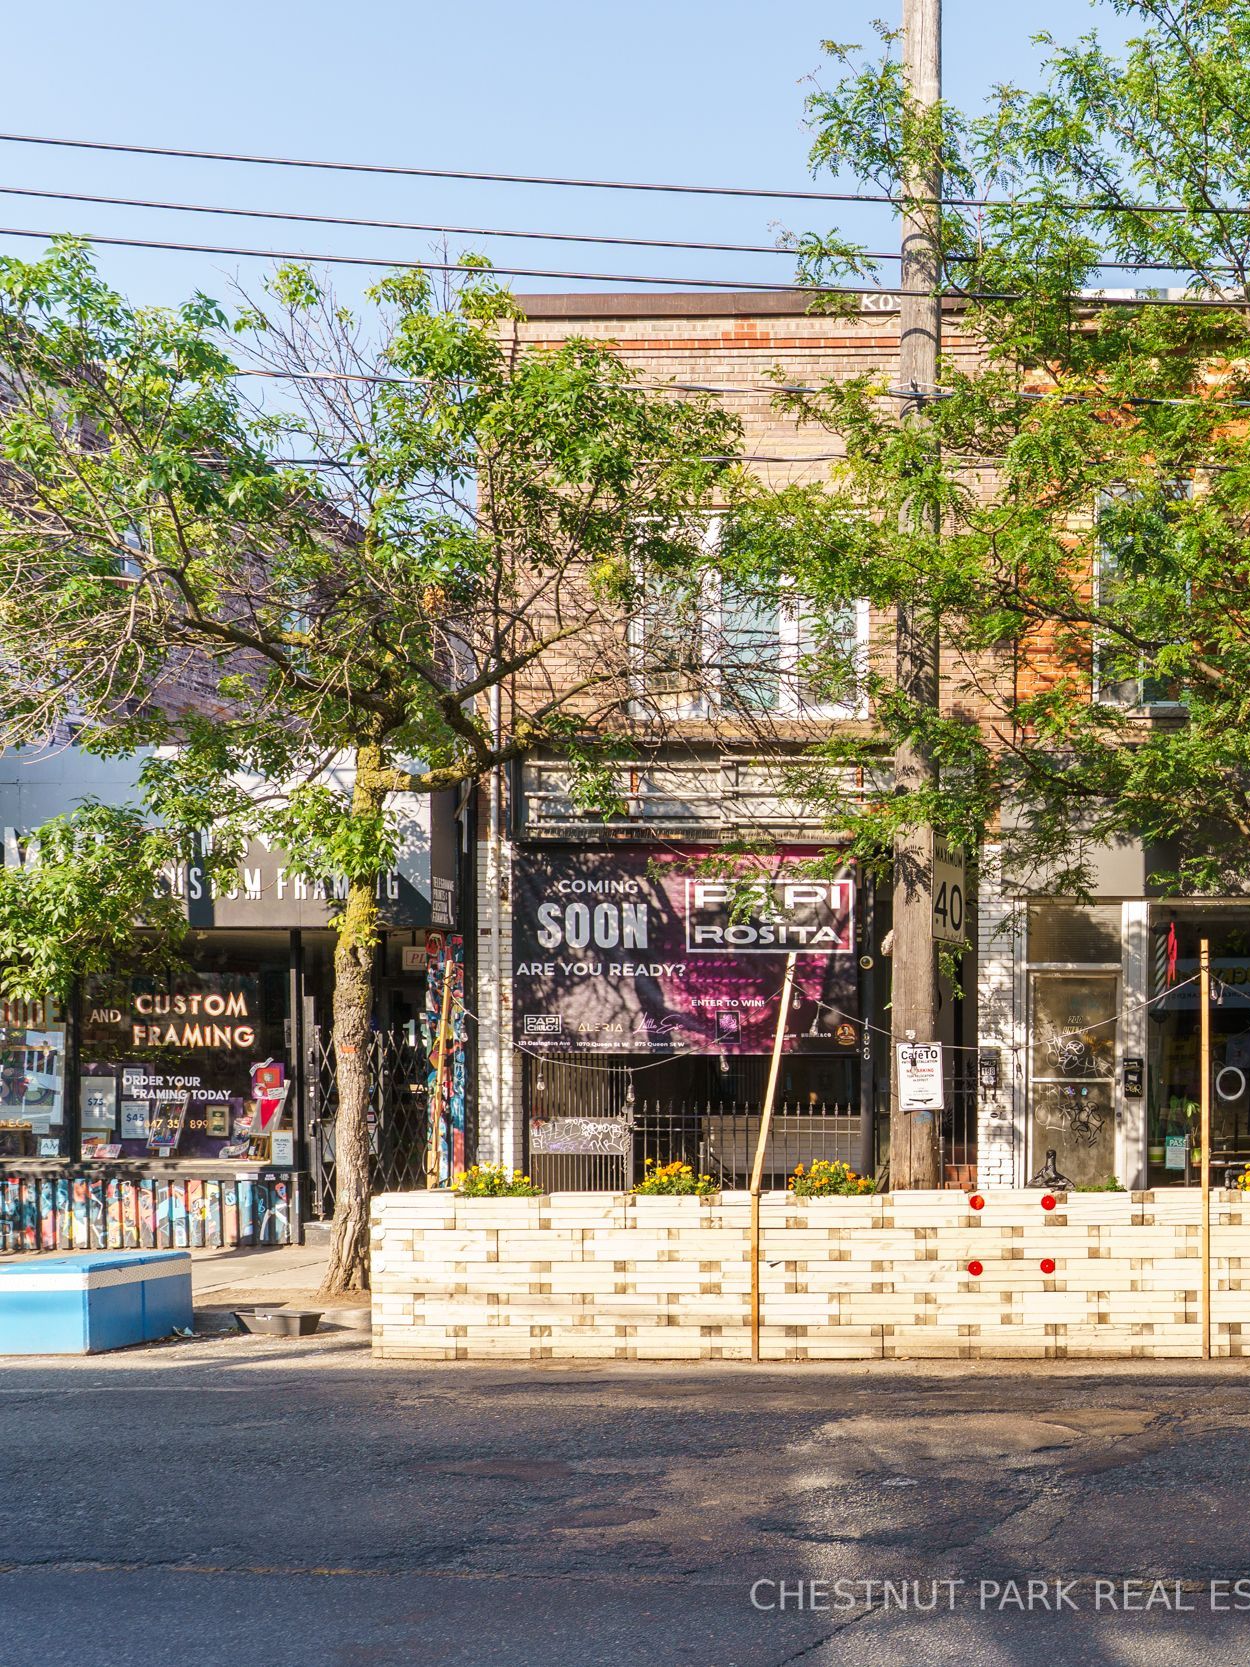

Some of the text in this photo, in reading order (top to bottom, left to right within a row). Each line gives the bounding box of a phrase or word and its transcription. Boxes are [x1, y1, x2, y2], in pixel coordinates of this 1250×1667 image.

[277, 867, 399, 900] FRAMG
[558, 879, 639, 894] COMING
[934, 881, 963, 931] 40
[537, 902, 649, 949] SOON
[694, 925, 843, 945] ROSITA
[516, 963, 687, 978] ARE YOU READY?
[135, 992, 248, 1018] CUSTOM
[691, 999, 765, 1008] ENTER TO WIN!
[89, 1009, 122, 1023] AND
[526, 1017, 559, 1025] PAPI
[526, 1024, 559, 1032] CHULO'S
[578, 1022, 623, 1032] ALERIA
[133, 1023, 255, 1049] FRAMING
[901, 1049, 938, 1060] CaféTO
[981, 1067, 996, 1075] 198
[122, 1076, 163, 1086] ORDER
[166, 1076, 201, 1087] YOUR
[132, 1089, 231, 1100] FRAMING TODAY
[87, 1098, 104, 1106] $75
[126, 1113, 145, 1123] $45
[189, 1119, 209, 1128] 899
